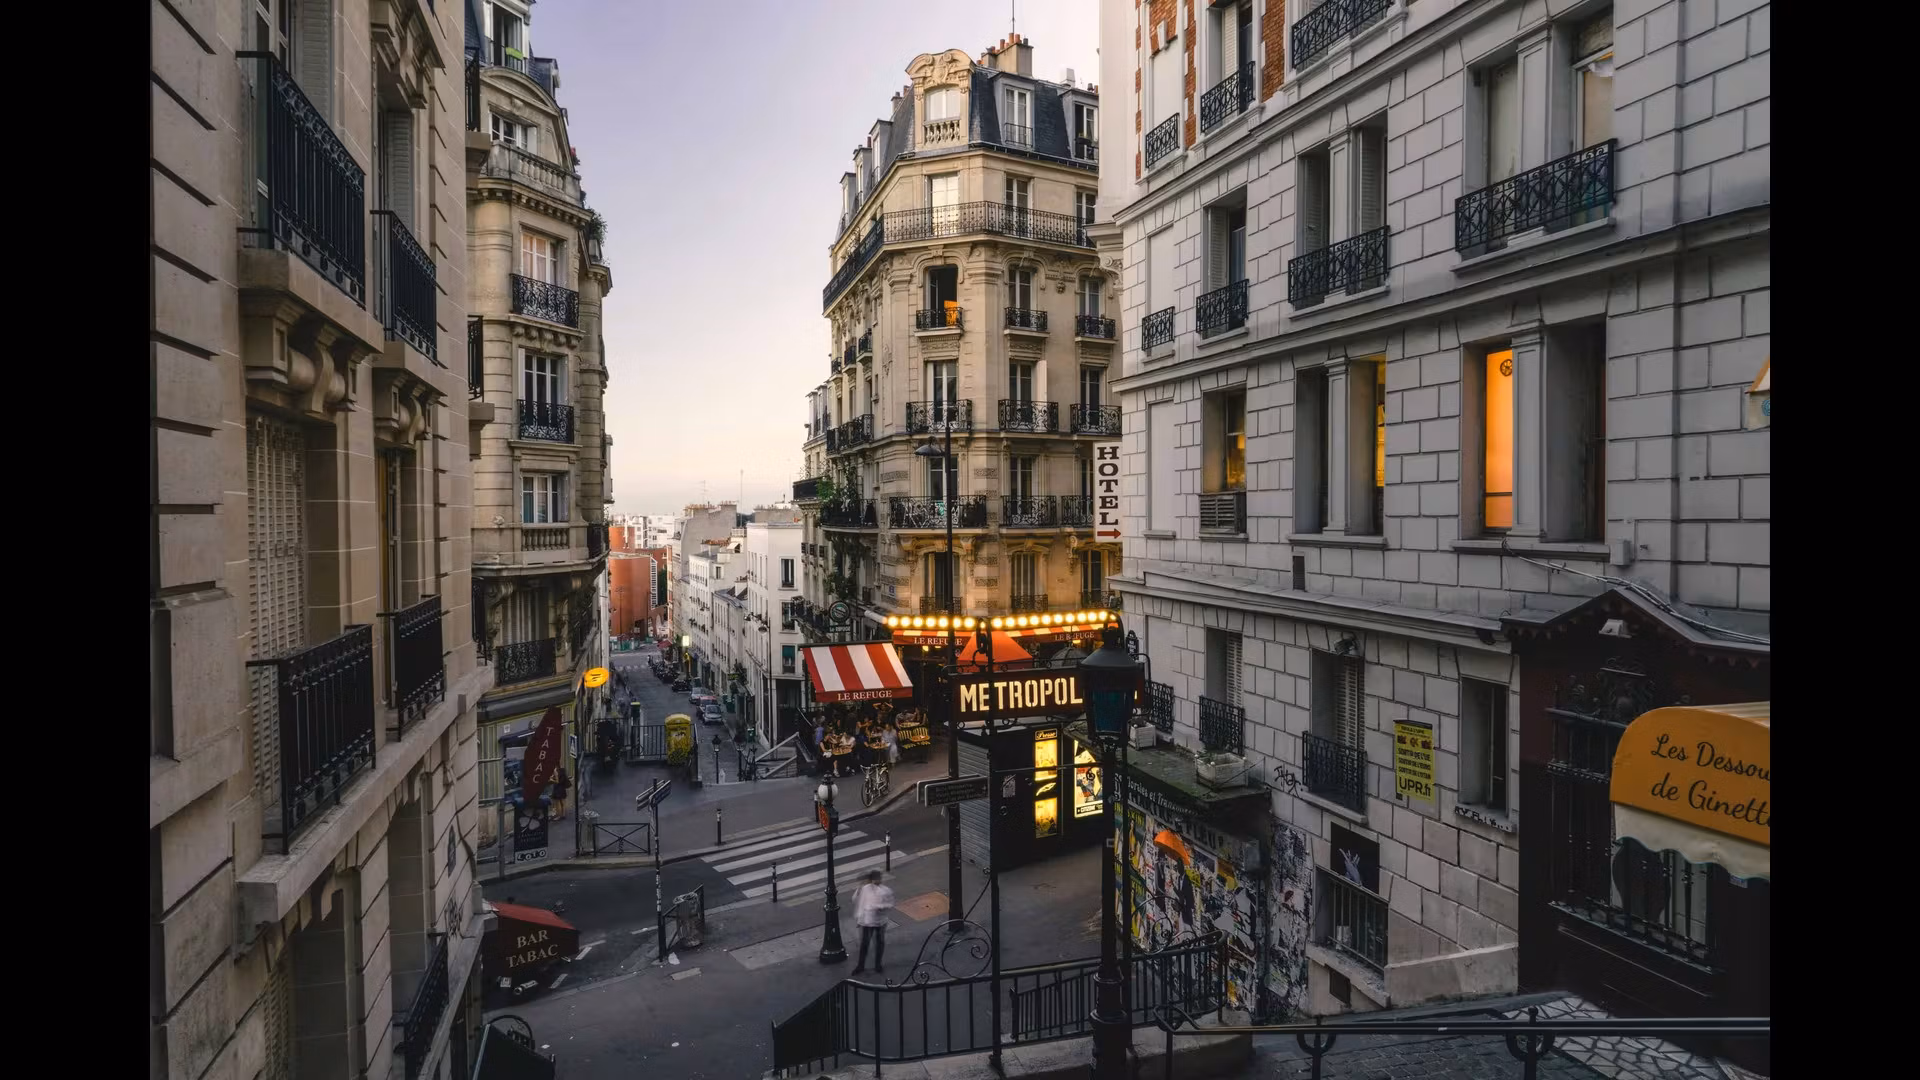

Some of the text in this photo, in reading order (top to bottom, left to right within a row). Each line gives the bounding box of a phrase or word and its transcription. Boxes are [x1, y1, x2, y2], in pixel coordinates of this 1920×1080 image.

[1097, 446, 1119, 525] HOTEL
[914, 637, 963, 646] LE REFUE
[837, 690, 893, 701] LE REFUGE
[532, 727, 554, 784] TABAC
[1651, 734, 1688, 761] Les
[1399, 776, 1431, 797] UPR.fr
[1651, 772, 1680, 800] de
[517, 850, 546, 861] LOTO
[506, 929, 559, 968] BAR TABAC
